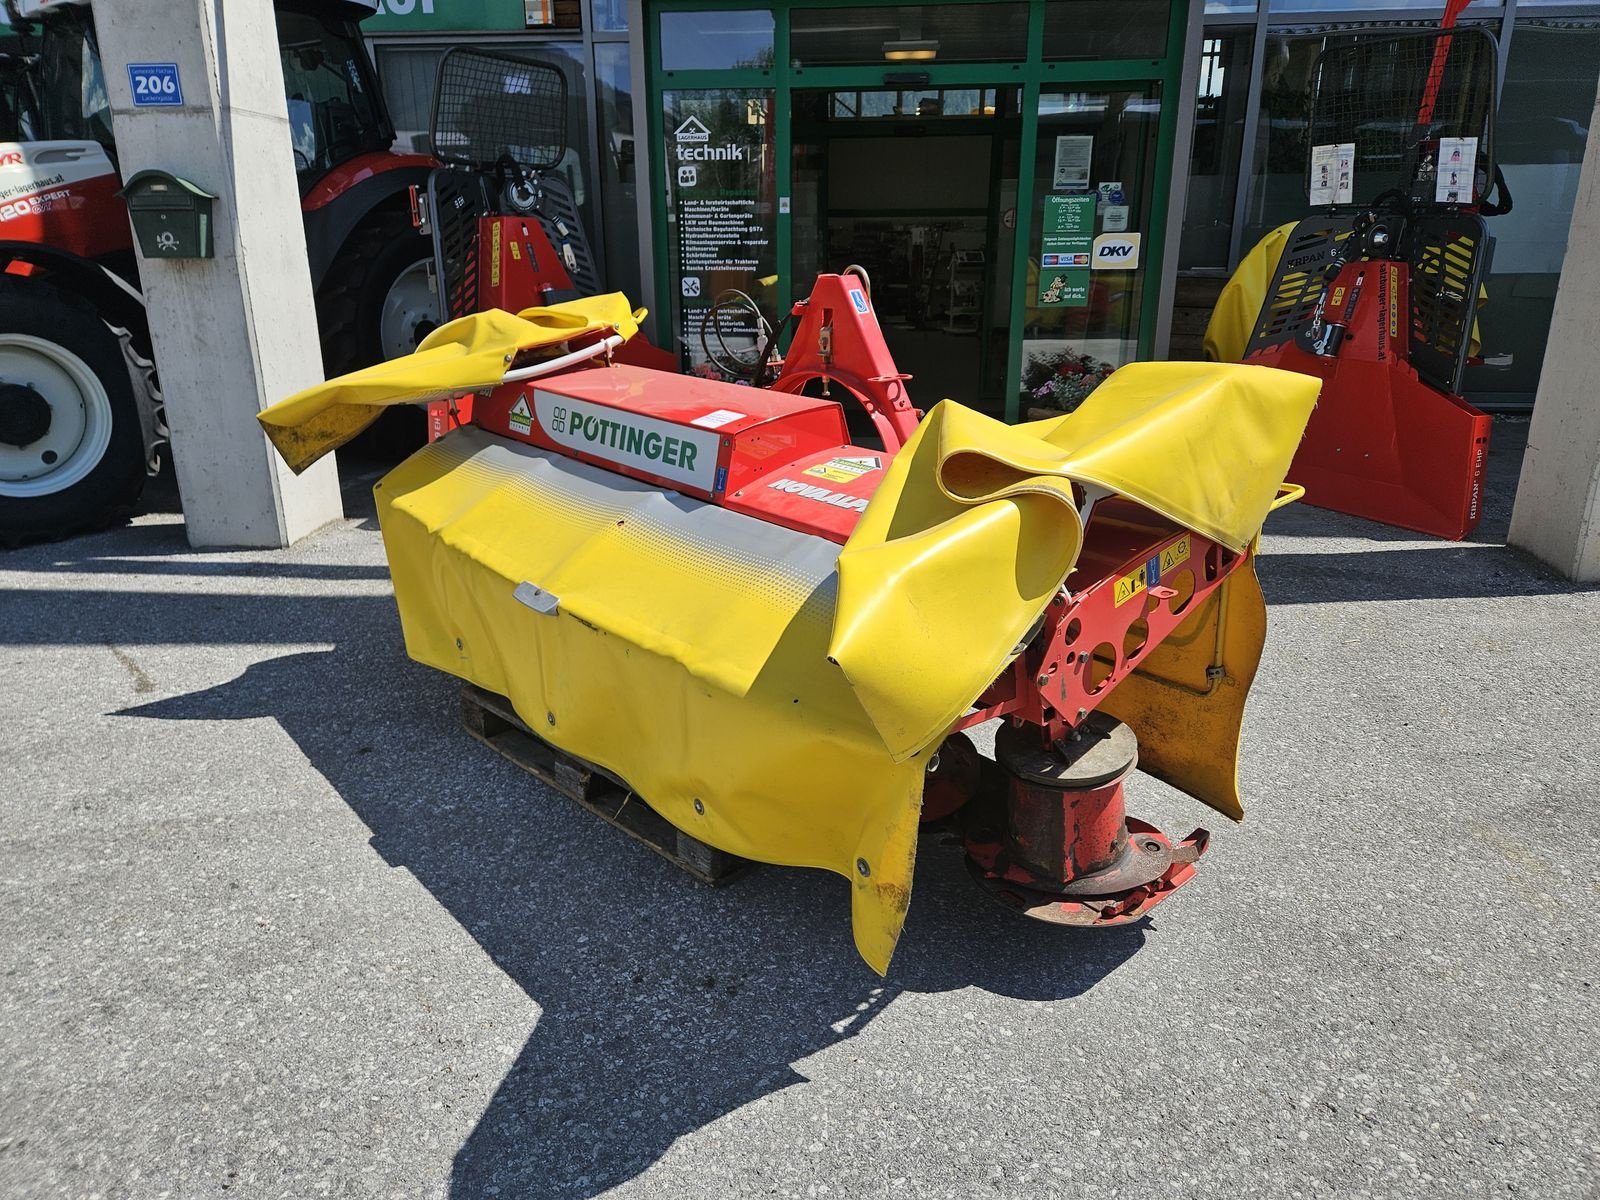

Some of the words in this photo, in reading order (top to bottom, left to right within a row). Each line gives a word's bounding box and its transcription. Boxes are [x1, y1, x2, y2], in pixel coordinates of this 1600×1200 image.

[135, 75, 176, 94] 206
[676, 143, 743, 161] technik
[29, 189, 71, 205] EXPERT
[1099, 246, 1134, 257] DKV
[1377, 263, 1387, 361] salzburger-lagerhaus.at
[569, 411, 699, 472] PÖTTINGER
[1470, 484, 1480, 520] KRPAN
